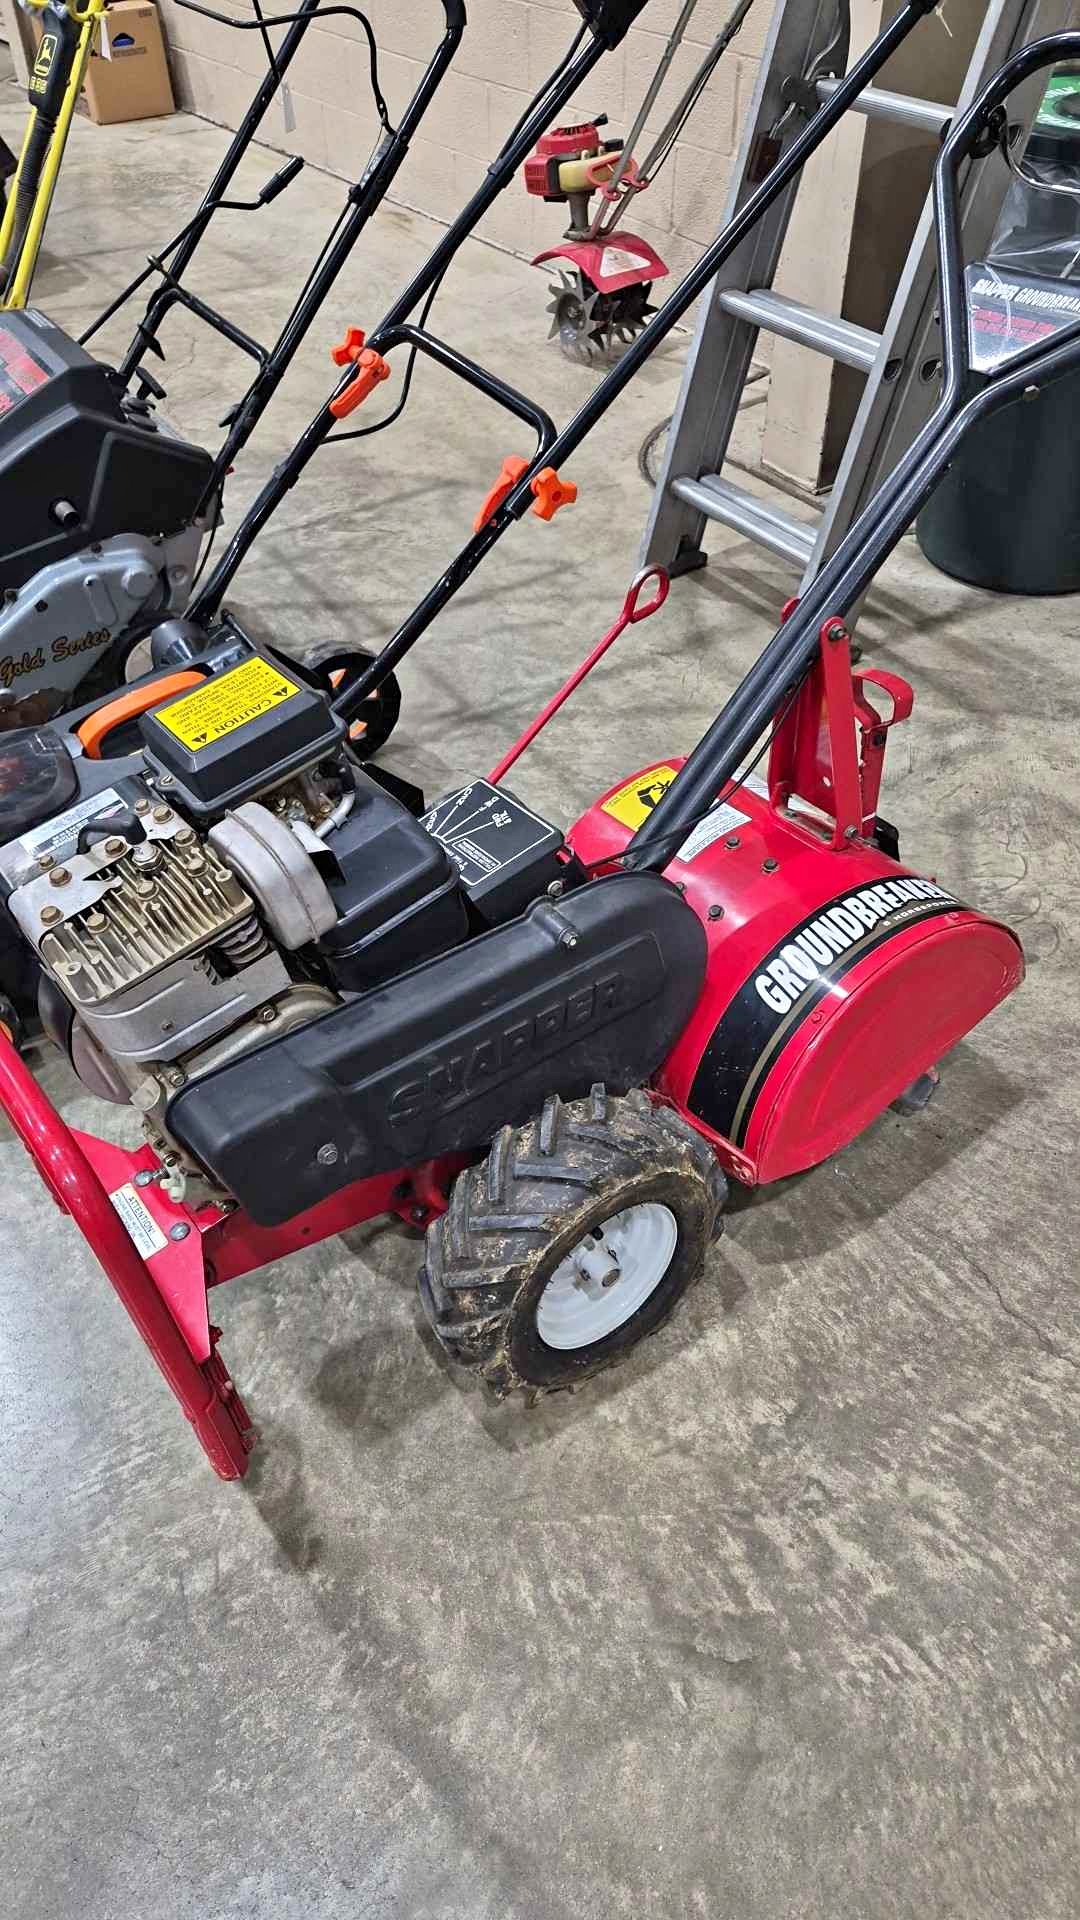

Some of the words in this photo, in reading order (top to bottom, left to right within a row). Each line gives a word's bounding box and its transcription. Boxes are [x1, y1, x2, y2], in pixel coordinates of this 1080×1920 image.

[51, 627, 112, 663] Series
[214, 699, 272, 734] CAUTION
[389, 972, 627, 1128] SNAPPER
